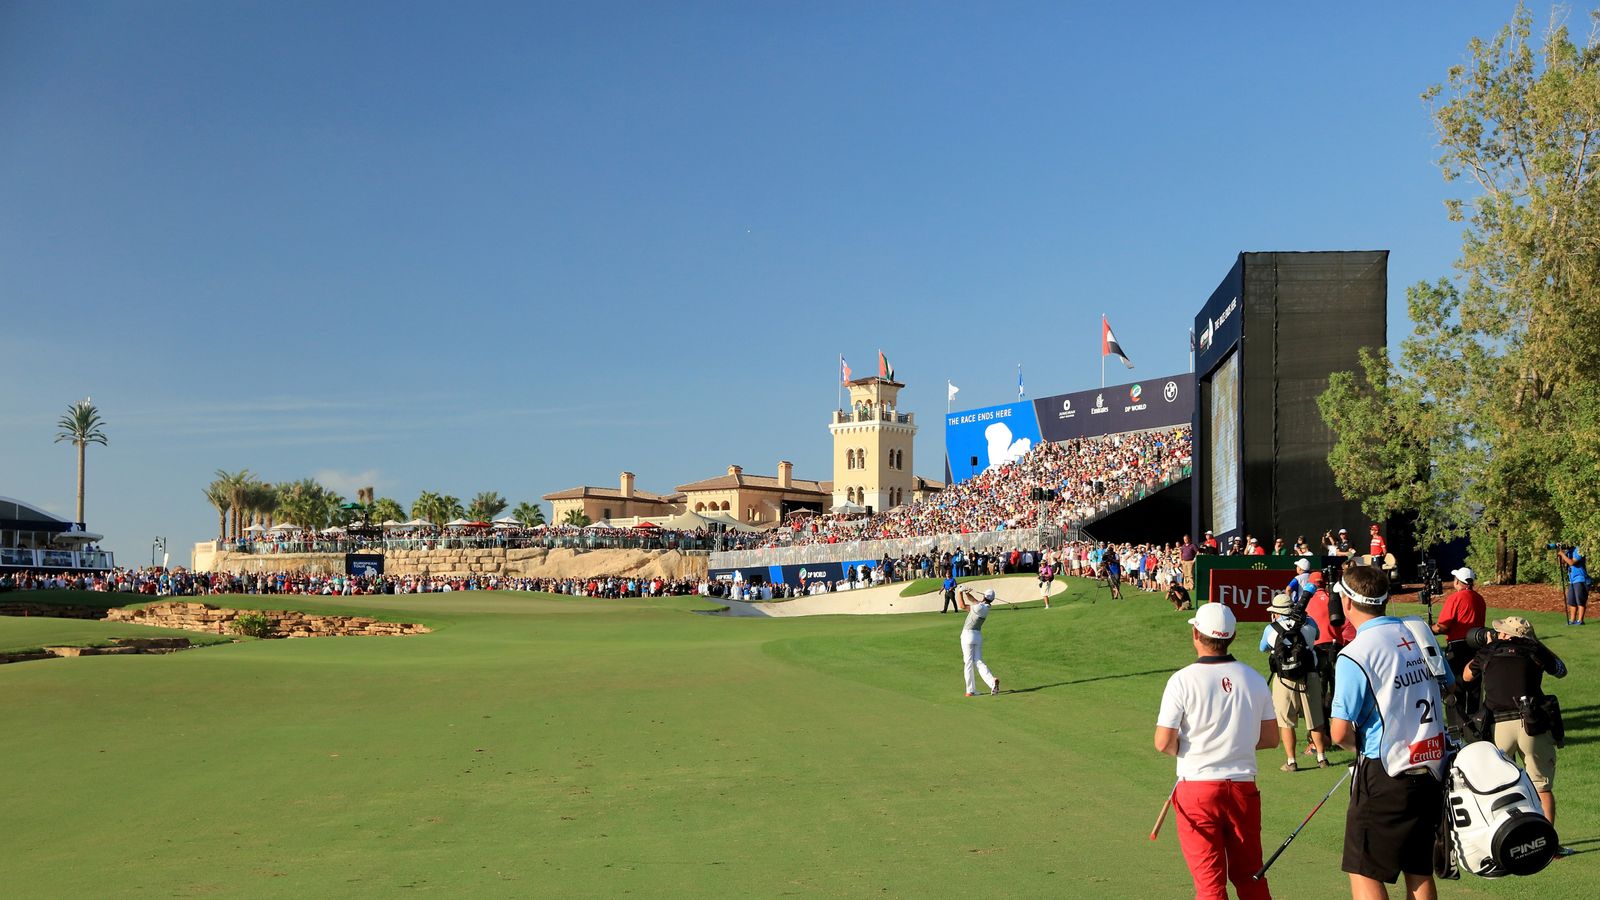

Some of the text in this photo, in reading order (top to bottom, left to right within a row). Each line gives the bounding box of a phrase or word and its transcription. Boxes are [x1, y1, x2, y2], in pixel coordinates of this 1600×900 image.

[1131, 403, 1147, 412] WORLD
[948, 408, 1012, 426] THE RACE ENDS HERE
[813, 570, 827, 578] WORLD
[1219, 585, 1252, 609] Fly
[1211, 630, 1229, 638] PING
[1406, 657, 1426, 668] Andy
[1416, 696, 1438, 725] 21
[1427, 739, 1439, 749] Fly
[1510, 837, 1546, 857] PING
